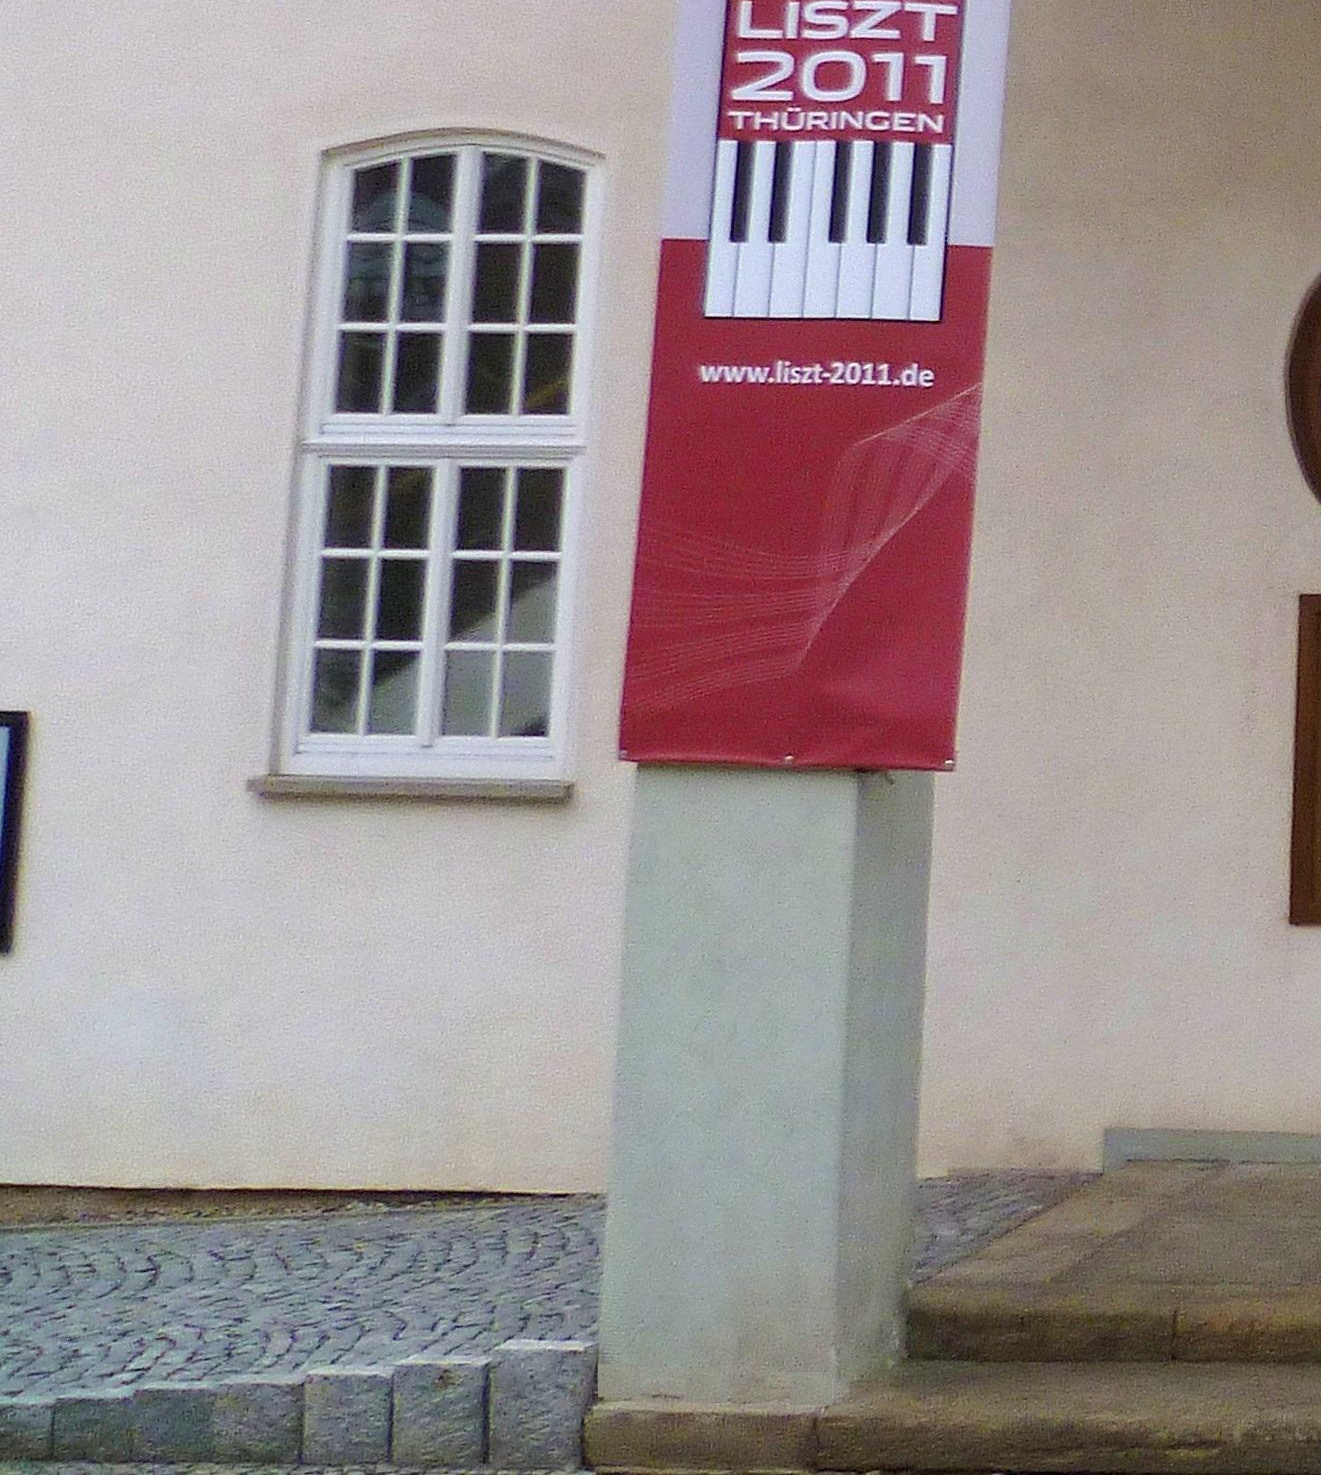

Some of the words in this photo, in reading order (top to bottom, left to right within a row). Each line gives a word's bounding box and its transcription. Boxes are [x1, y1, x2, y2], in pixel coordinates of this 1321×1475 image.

[737, 0, 959, 42] LISZT
[731, 50, 948, 105] 2011
[727, 107, 944, 133] THÜRINGEN
[699, 359, 935, 387] www.liszt-2011.de
